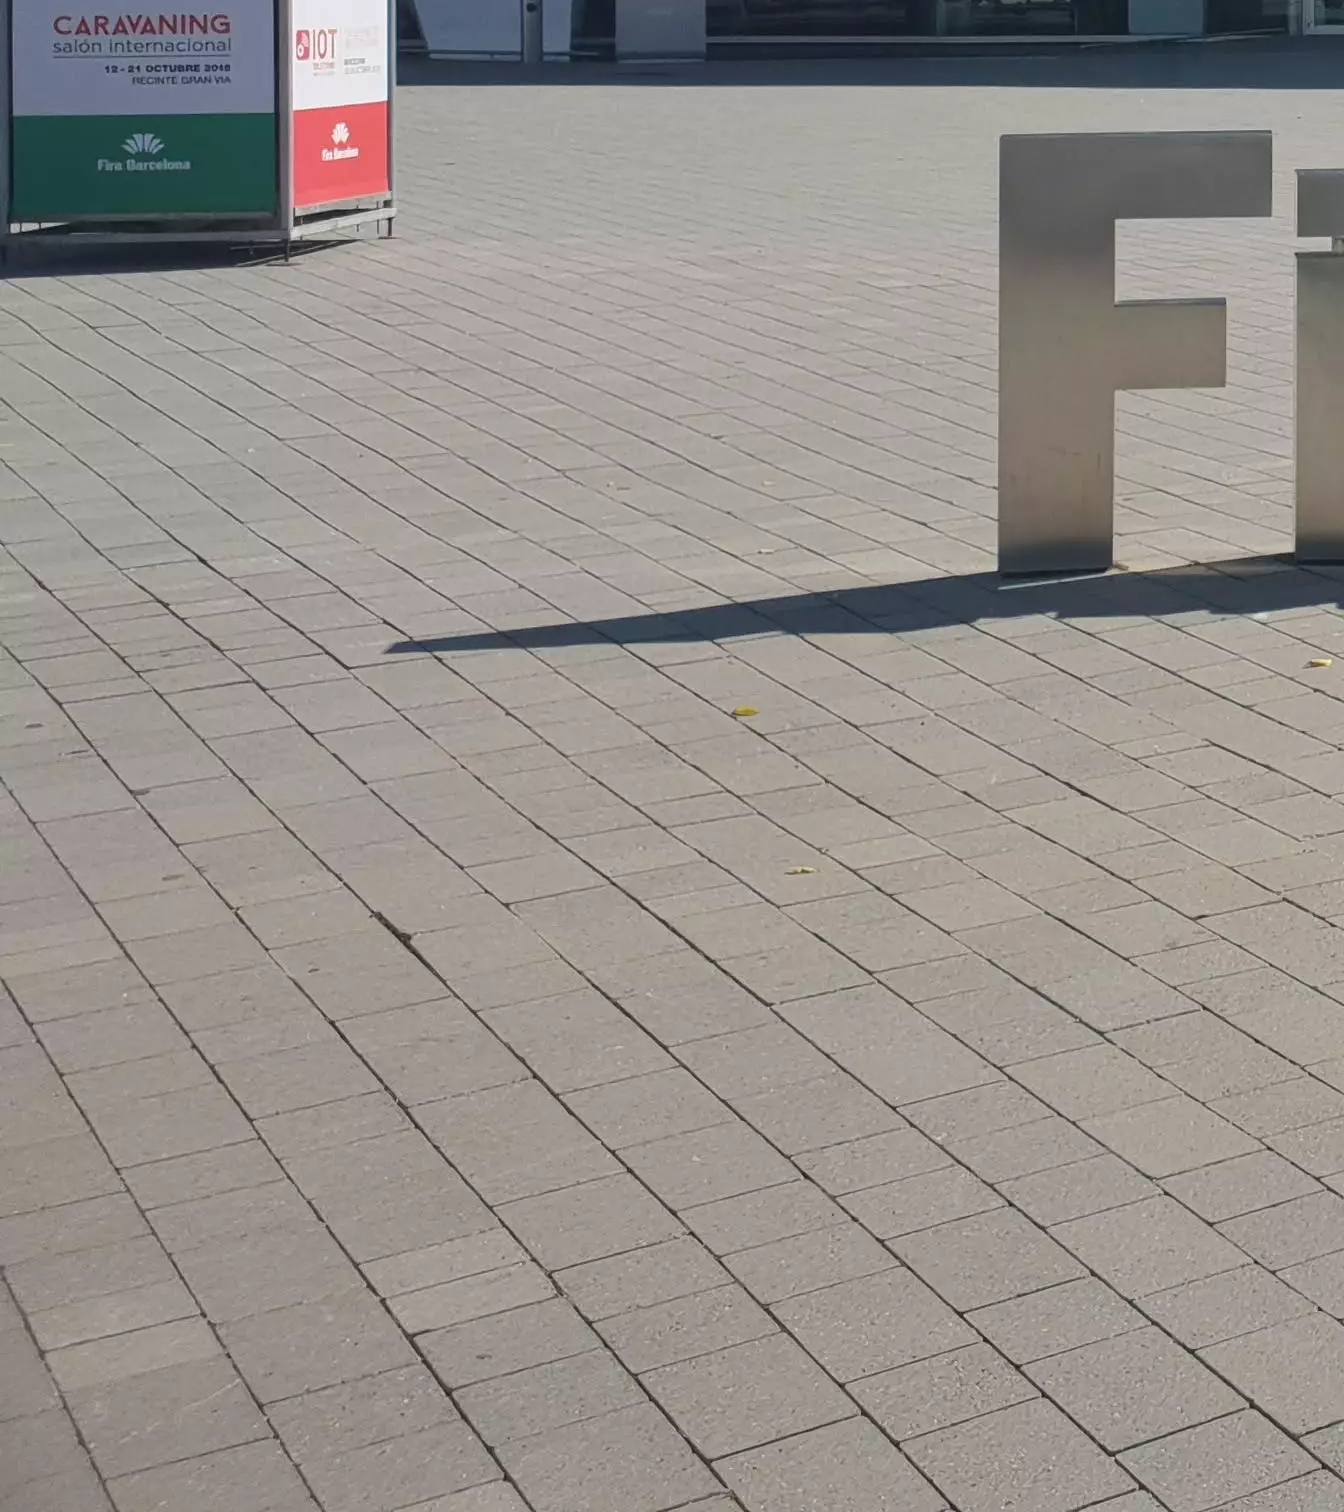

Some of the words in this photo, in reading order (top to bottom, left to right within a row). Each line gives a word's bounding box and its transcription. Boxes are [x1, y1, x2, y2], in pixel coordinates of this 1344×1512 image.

[53, 14, 231, 36] CARAVANING
[52, 38, 102, 54] salón
[109, 37, 232, 54] internacional
[312, 28, 338, 60] IOT
[145, 63, 201, 74] OCTUBRE
[97, 159, 123, 172] Fira
[126, 158, 191, 172] Barcelona
